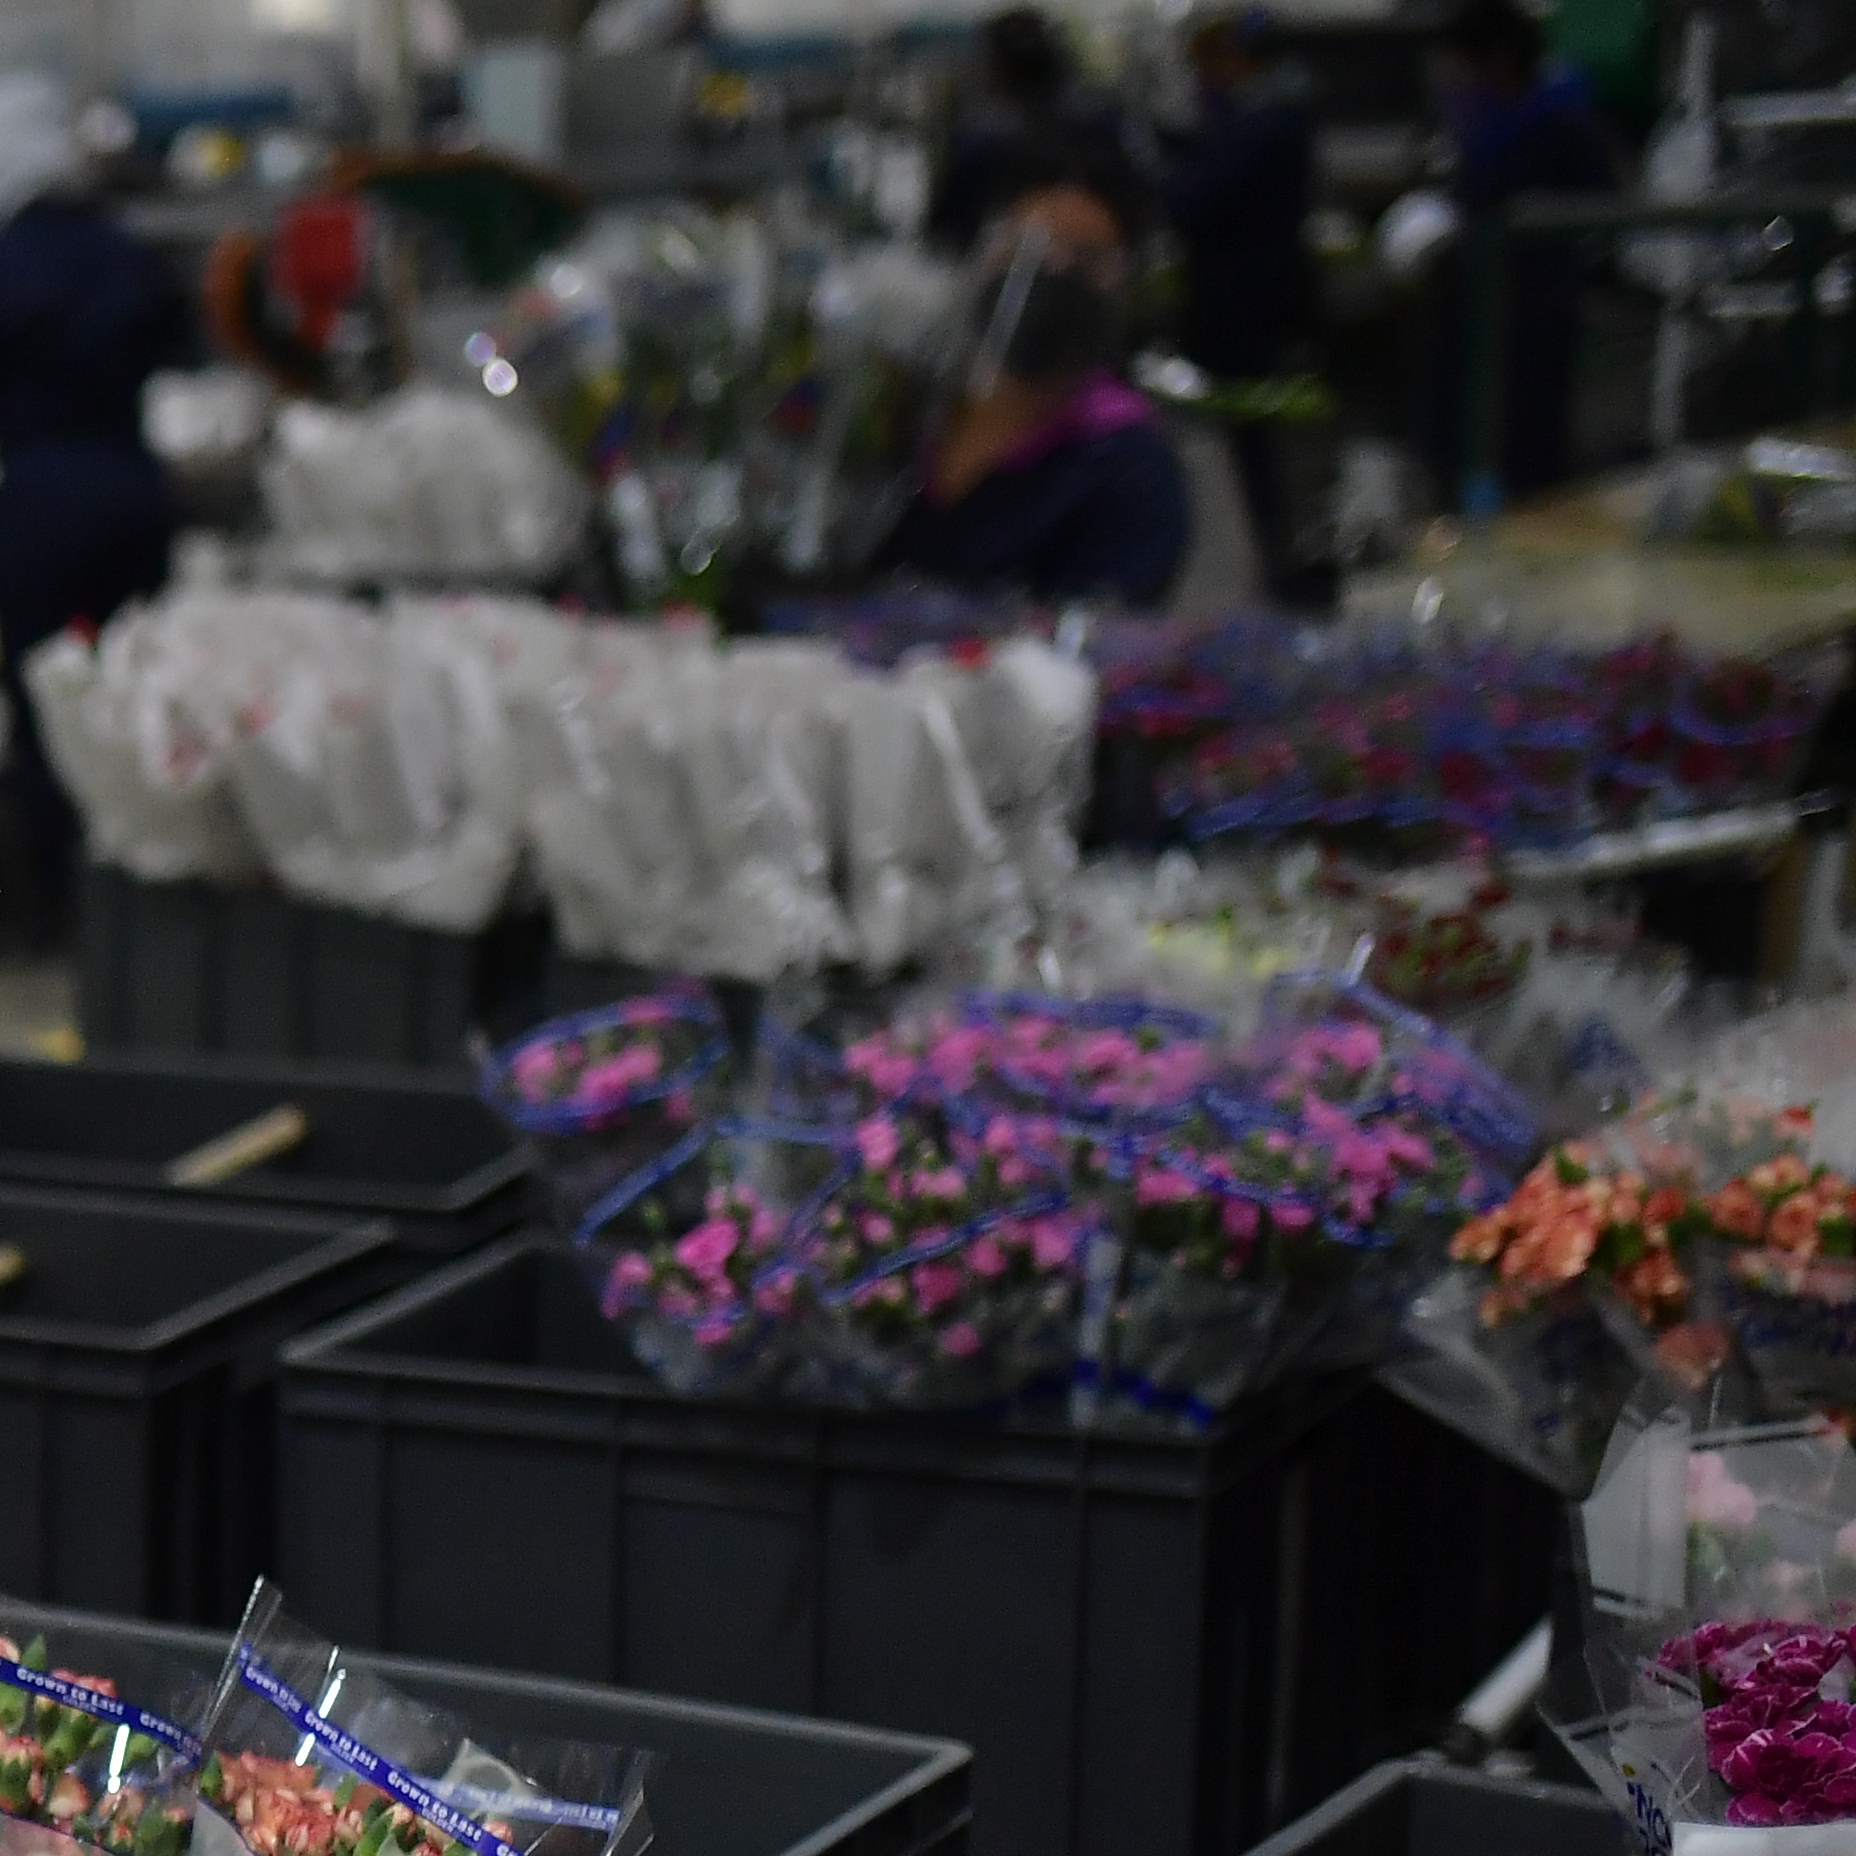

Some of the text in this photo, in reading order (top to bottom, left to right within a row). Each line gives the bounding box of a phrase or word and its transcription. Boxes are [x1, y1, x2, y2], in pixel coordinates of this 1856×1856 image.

[16, 1666, 67, 1694] Grown
[91, 1690, 125, 1717] Last
[387, 1770, 431, 1808] Grown
[432, 1801, 448, 1819] to
[450, 1813, 482, 1843] Last
